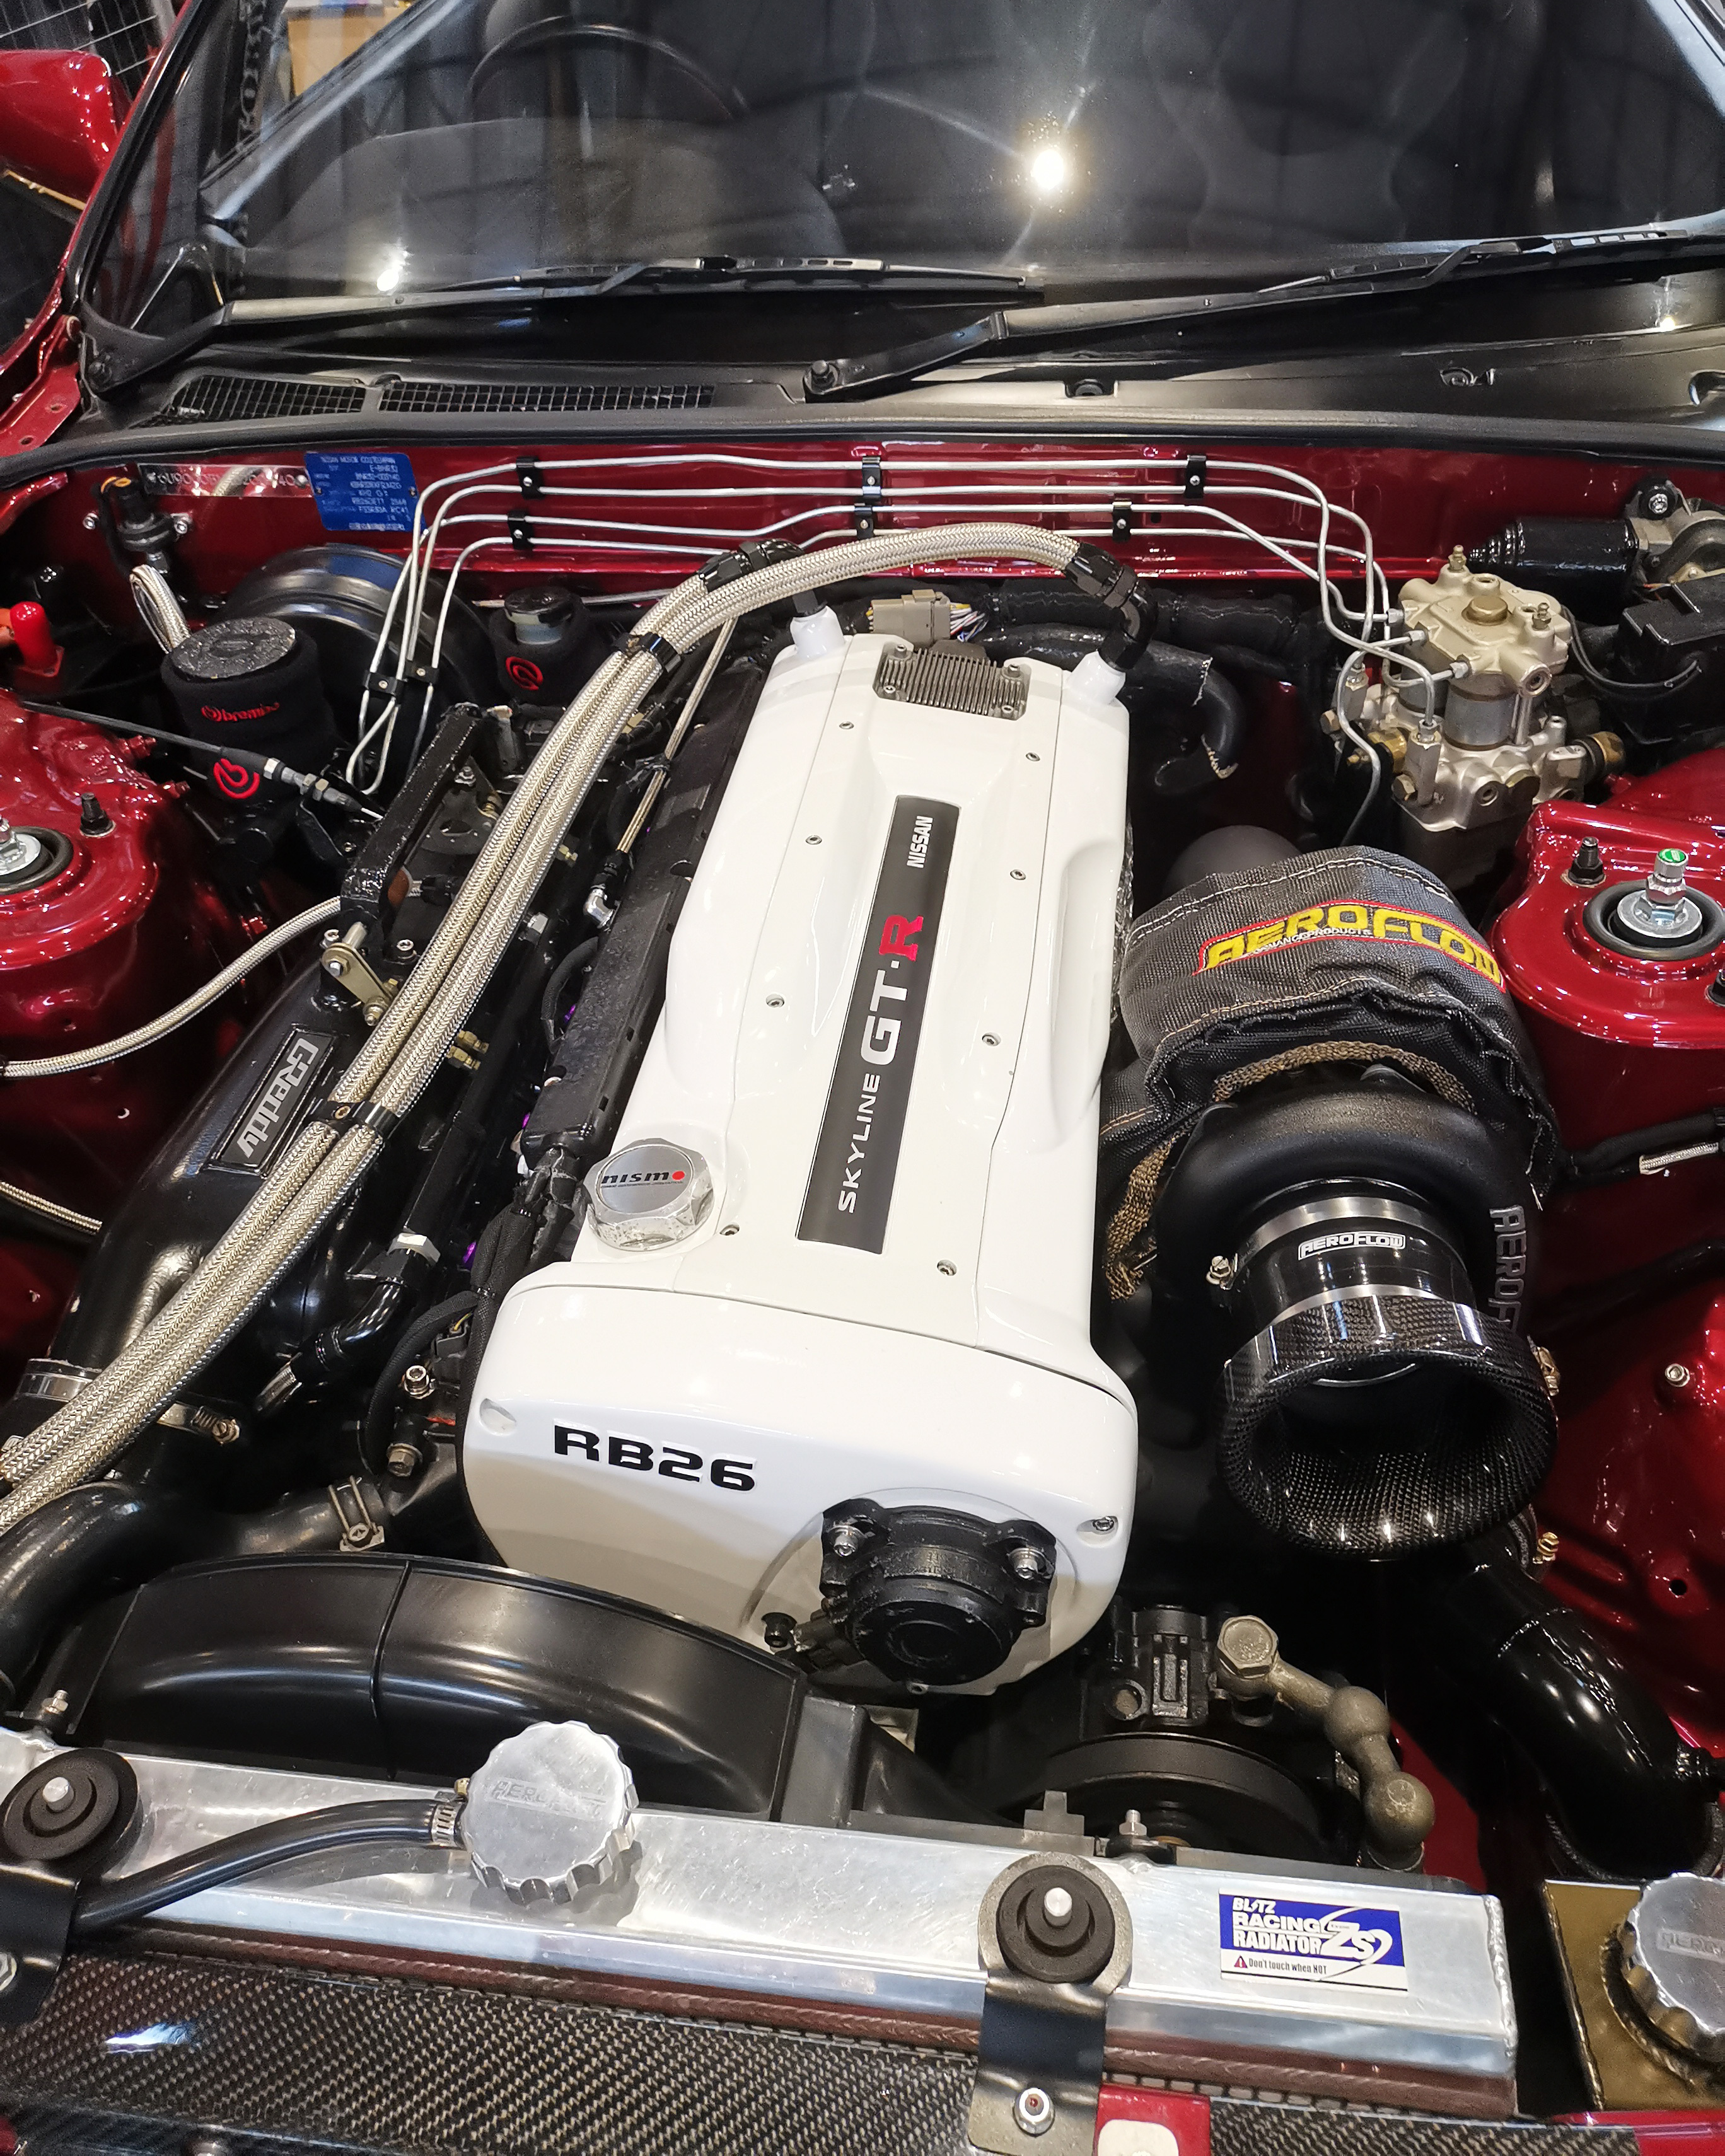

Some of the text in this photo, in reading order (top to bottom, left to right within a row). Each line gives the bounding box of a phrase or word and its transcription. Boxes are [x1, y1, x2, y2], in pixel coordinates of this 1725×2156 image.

[907, 815, 933, 868] NISSAN
[1203, 904, 1501, 984] AEROFLOW
[237, 1038, 319, 1159] GReddy
[838, 1073, 880, 1214] SKYLINE
[601, 1171, 685, 1184] nismo
[1301, 1234, 1403, 1257] AEROFLOW
[554, 1425, 756, 1492] RB26
[1233, 1897, 1276, 1914] BLITZ
[1233, 1911, 1322, 1933] RACING
[1233, 1930, 1322, 1955] RADIATOR
[1248, 1957, 1327, 1974] Don't touch when HOT
